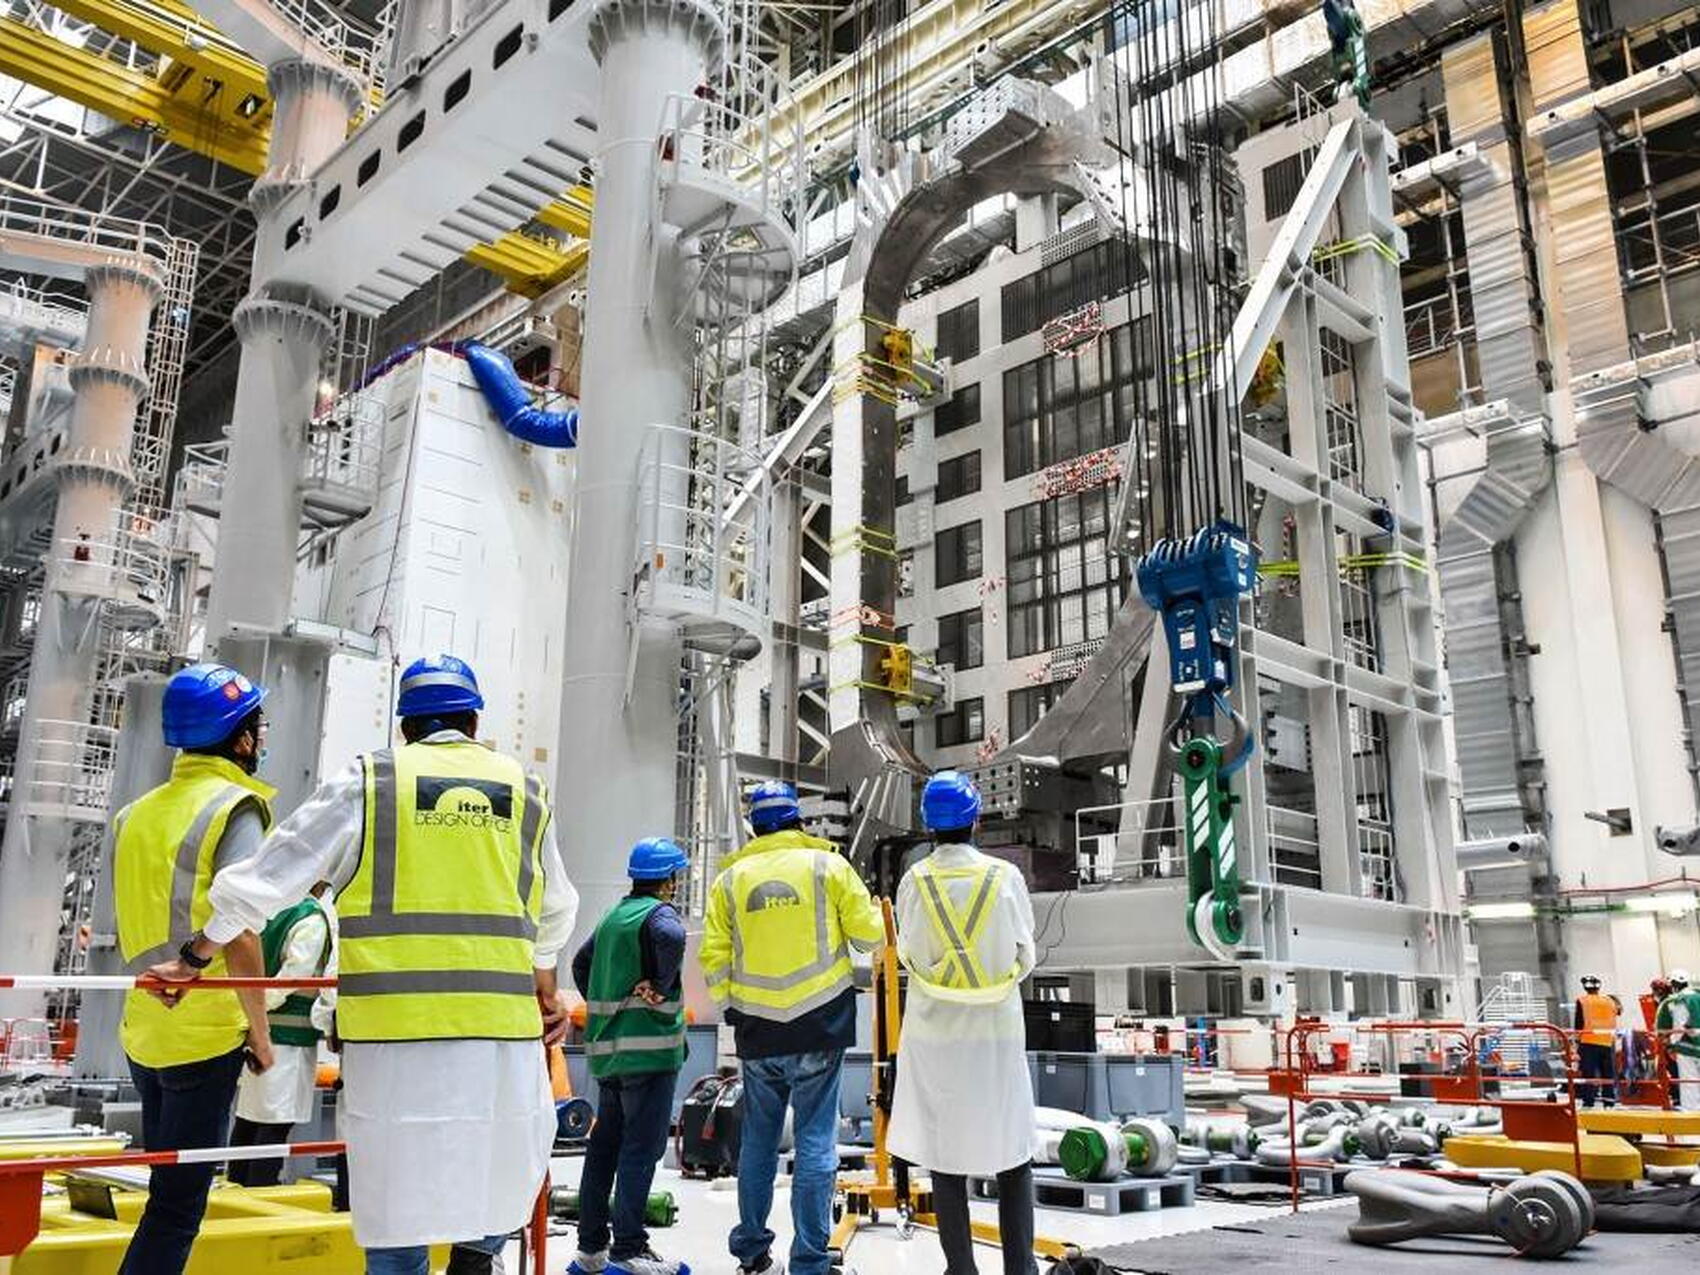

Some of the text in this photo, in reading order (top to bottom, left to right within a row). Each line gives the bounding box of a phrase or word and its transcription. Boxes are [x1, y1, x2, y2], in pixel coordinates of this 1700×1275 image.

[458, 799, 490, 813] iter
[415, 812, 512, 834] DESIGN OFCE
[763, 895, 797, 910] iter
